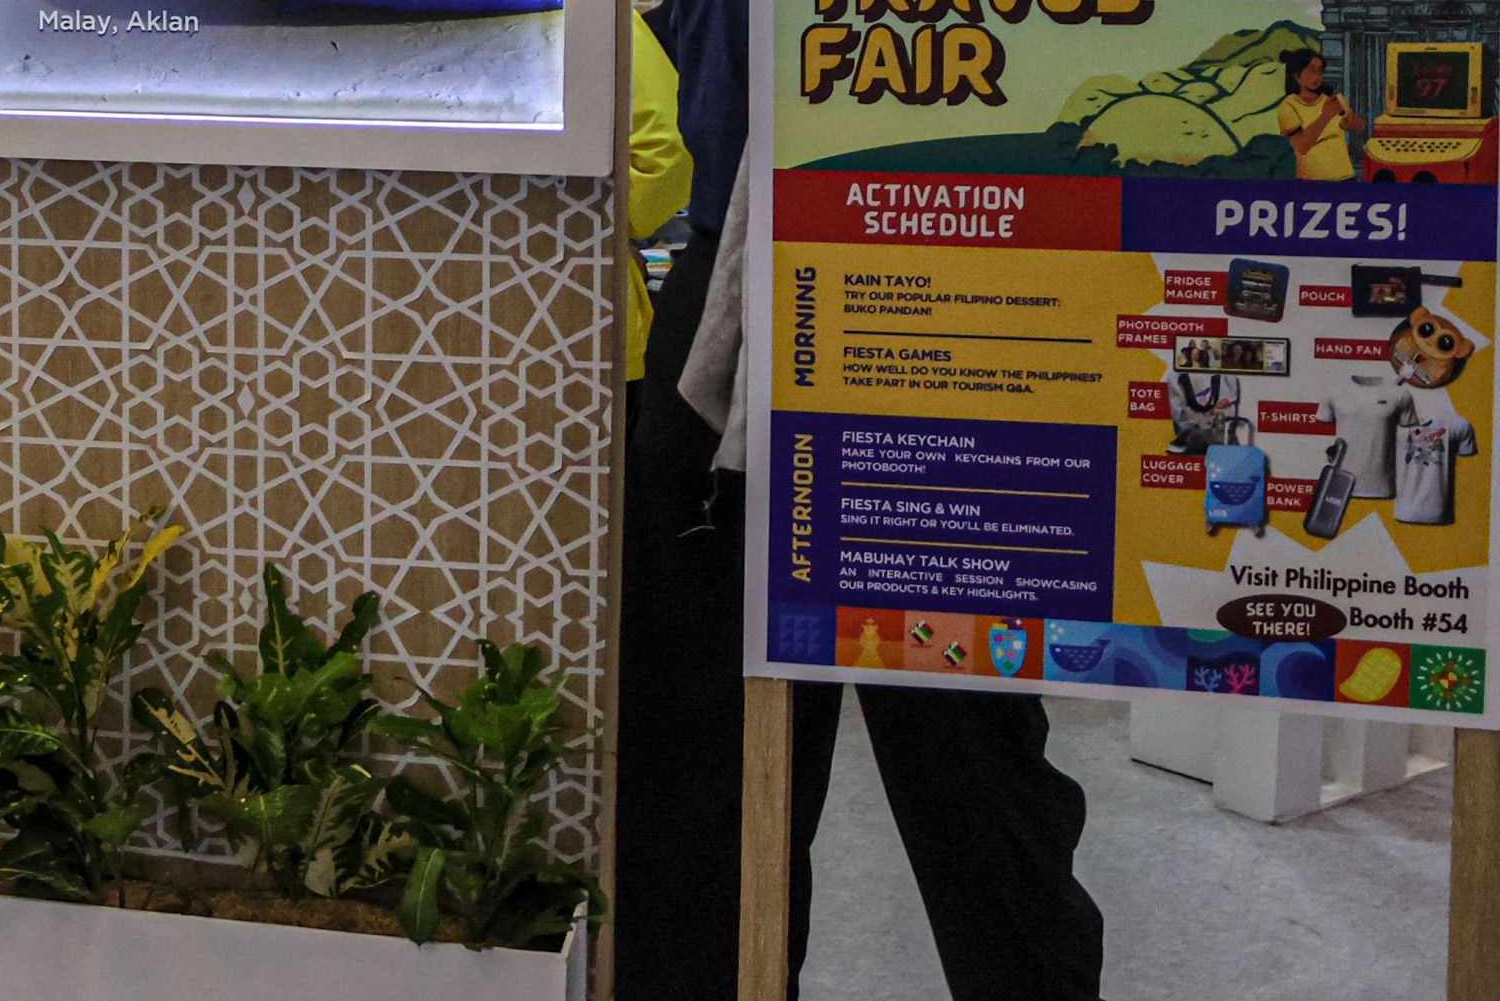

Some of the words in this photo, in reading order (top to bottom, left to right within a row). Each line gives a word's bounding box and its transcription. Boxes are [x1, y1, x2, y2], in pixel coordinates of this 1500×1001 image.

[39, 10, 118, 35] Malay,
[126, 11, 199, 32] Aklan
[801, 24, 1007, 106] FAIR
[846, 183, 1024, 210] ACTIVATION
[864, 211, 1015, 238] SCHEDULE
[1215, 199, 1409, 242] PRIZES!
[844, 274, 881, 287] KAIN
[885, 275, 931, 288] TAYO!
[1166, 276, 1211, 287] FRIDGE
[844, 291, 866, 301] TRY
[869, 292, 893, 301] OUR
[897, 292, 951, 303] POPULAR
[954, 294, 1002, 305] FILIPINO
[1166, 289, 1218, 300] MAGNET
[1301, 291, 1345, 302] POUCH
[844, 304, 876, 314] BUKO
[879, 305, 932, 316] PANDAN!
[795, 266, 816, 387] MORNING
[1118, 320, 1204, 332] PHOTOBOOTH
[1118, 333, 1168, 345] FRAMES
[844, 347, 894, 359] FIESTA
[899, 349, 952, 362] GAMES
[1316, 344, 1353, 355] HAND
[1356, 345, 1382, 356] FAN
[843, 364, 873, 374] HOW
[876, 365, 907, 375] WELL
[911, 365, 928, 375] DO
[932, 366, 956, 376] YOU
[959, 367, 998, 379] KNOW
[1002, 369, 1023, 379] THE
[1026, 370, 1102, 383] PHILIPPINES?
[843, 377, 873, 387] TAKE
[876, 378, 905, 388] PART
[909, 379, 920, 388] IN
[924, 380, 948, 390] OUR
[952, 381, 1004, 392] TOURISM
[1130, 388, 1161, 399] TOTE
[1130, 401, 1155, 412] BAG
[1260, 412, 1317, 423] T-SHIRTS
[842, 431, 893, 444] FIESTA
[897, 434, 975, 448] KEYCHAIN
[841, 448, 874, 458] MAKE
[878, 449, 911, 460] YOUR
[915, 451, 946, 461] OWN
[955, 453, 1022, 465] KEYCHAINS
[1026, 457, 1060, 467] FROM
[1064, 458, 1090, 469] OUR
[1142, 460, 1201, 472] LUGGAGE
[841, 461, 926, 473] PHOTOBOOTH!
[1142, 472, 1184, 484] COVER
[1267, 483, 1313, 494] POWER
[792, 433, 814, 582] AFTERNOON
[841, 498, 892, 512] FIESTA
[896, 500, 931, 514] SING
[935, 502, 945, 514] &
[949, 503, 980, 517] WIN
[1267, 496, 1301, 507] BANK
[841, 514, 868, 525] SING
[870, 515, 881, 525] IT
[883, 516, 917, 528] RIGHT
[920, 518, 937, 528] OR
[984, 521, 999, 532] BE
[1002, 523, 1074, 536] ELIMINATED.
[840, 551, 915, 567] MABUHAY
[919, 555, 958, 569] TALK
[962, 558, 1010, 571] SHOW
[840, 567, 856, 577] AN
[868, 569, 943, 582] INTERACTIVE
[955, 573, 1004, 585] SESSION
[1016, 577, 1097, 591] SHOWCASING
[1230, 565, 1278, 587] Visit
[1285, 568, 1396, 597] Philippine
[1404, 575, 1469, 599] Booth
[839, 580, 864, 591] OUR
[867, 582, 928, 595] PRODUCTS
[931, 585, 939, 595] &
[942, 585, 964, 596] KEY
[1246, 602, 1274, 616] SEE
[1281, 603, 1316, 617] YOU
[1350, 607, 1413, 630] Booth
[1422, 613, 1468, 634] #54
[1252, 621, 1311, 636] THERE!
